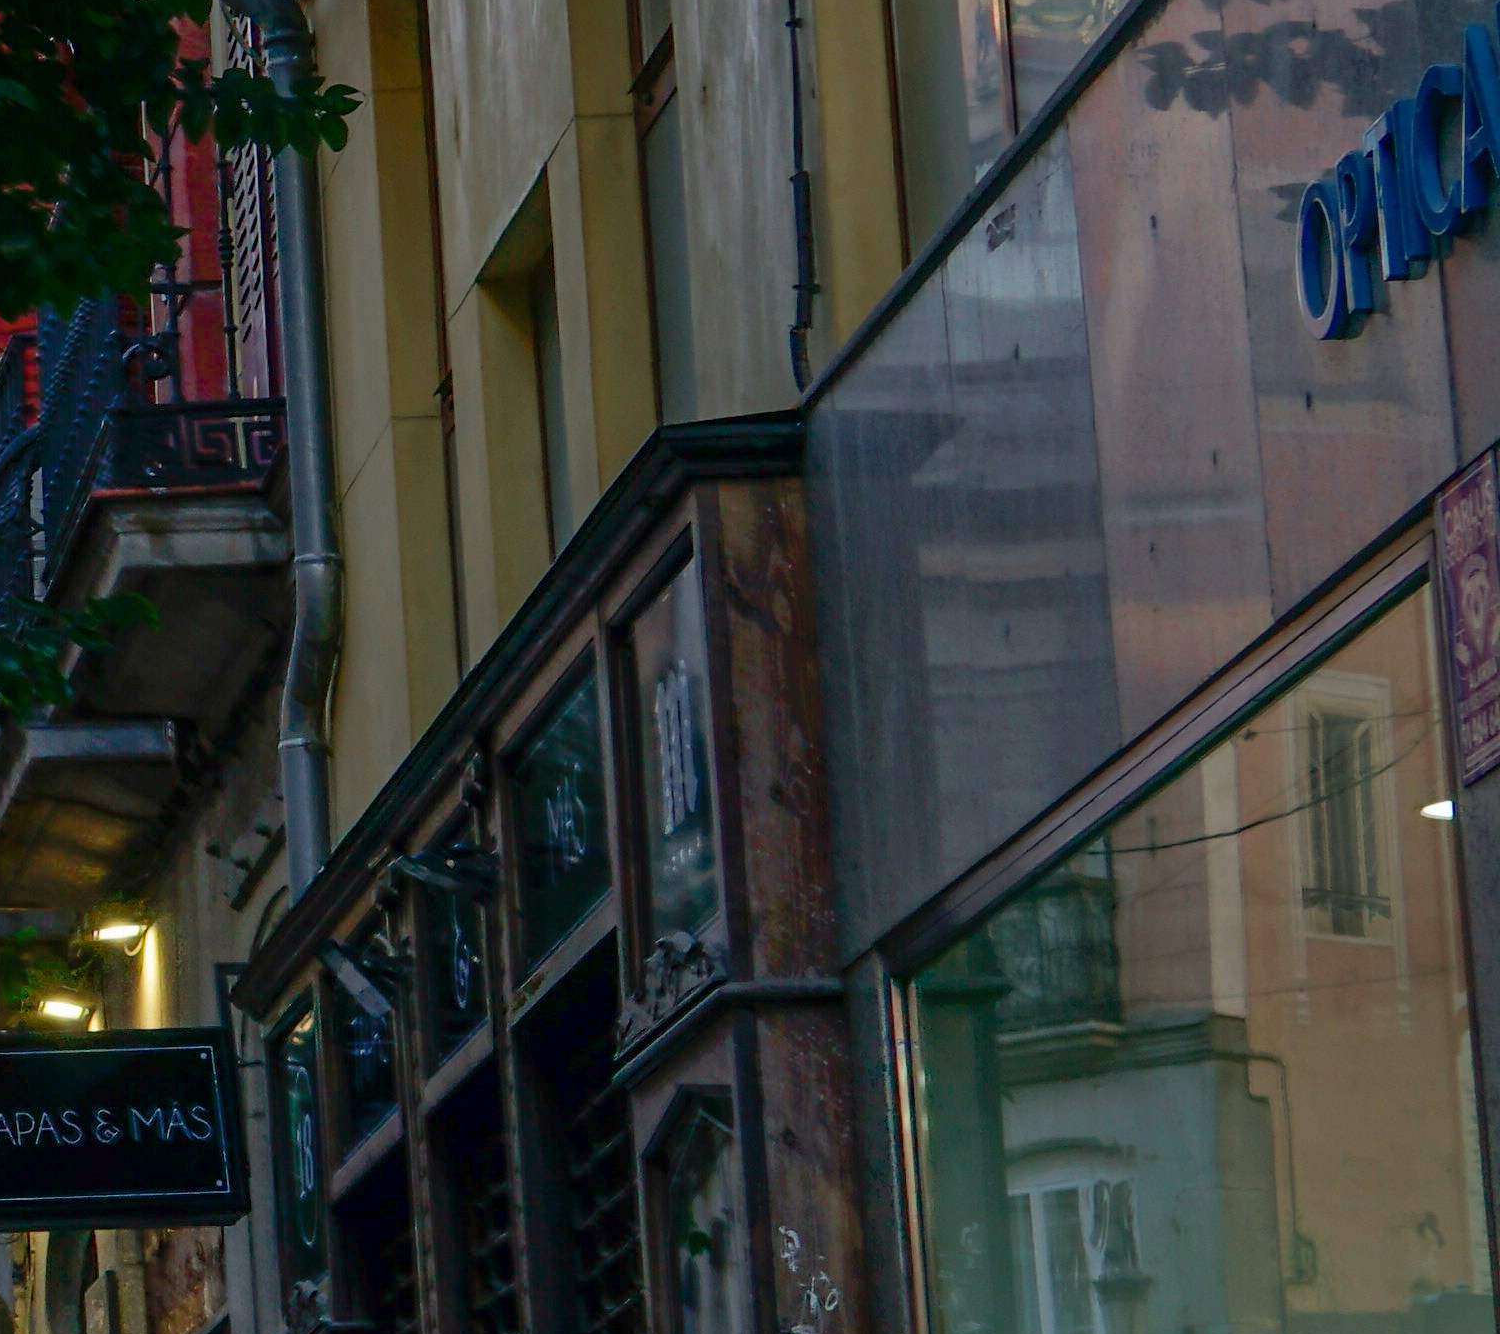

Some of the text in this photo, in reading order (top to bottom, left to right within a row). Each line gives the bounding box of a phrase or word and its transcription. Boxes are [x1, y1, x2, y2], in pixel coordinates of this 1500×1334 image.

[1296, 0, 1500, 340] OPTICA
[94, 1108, 119, 1145] &
[132, 1100, 213, 1143] MÁS
